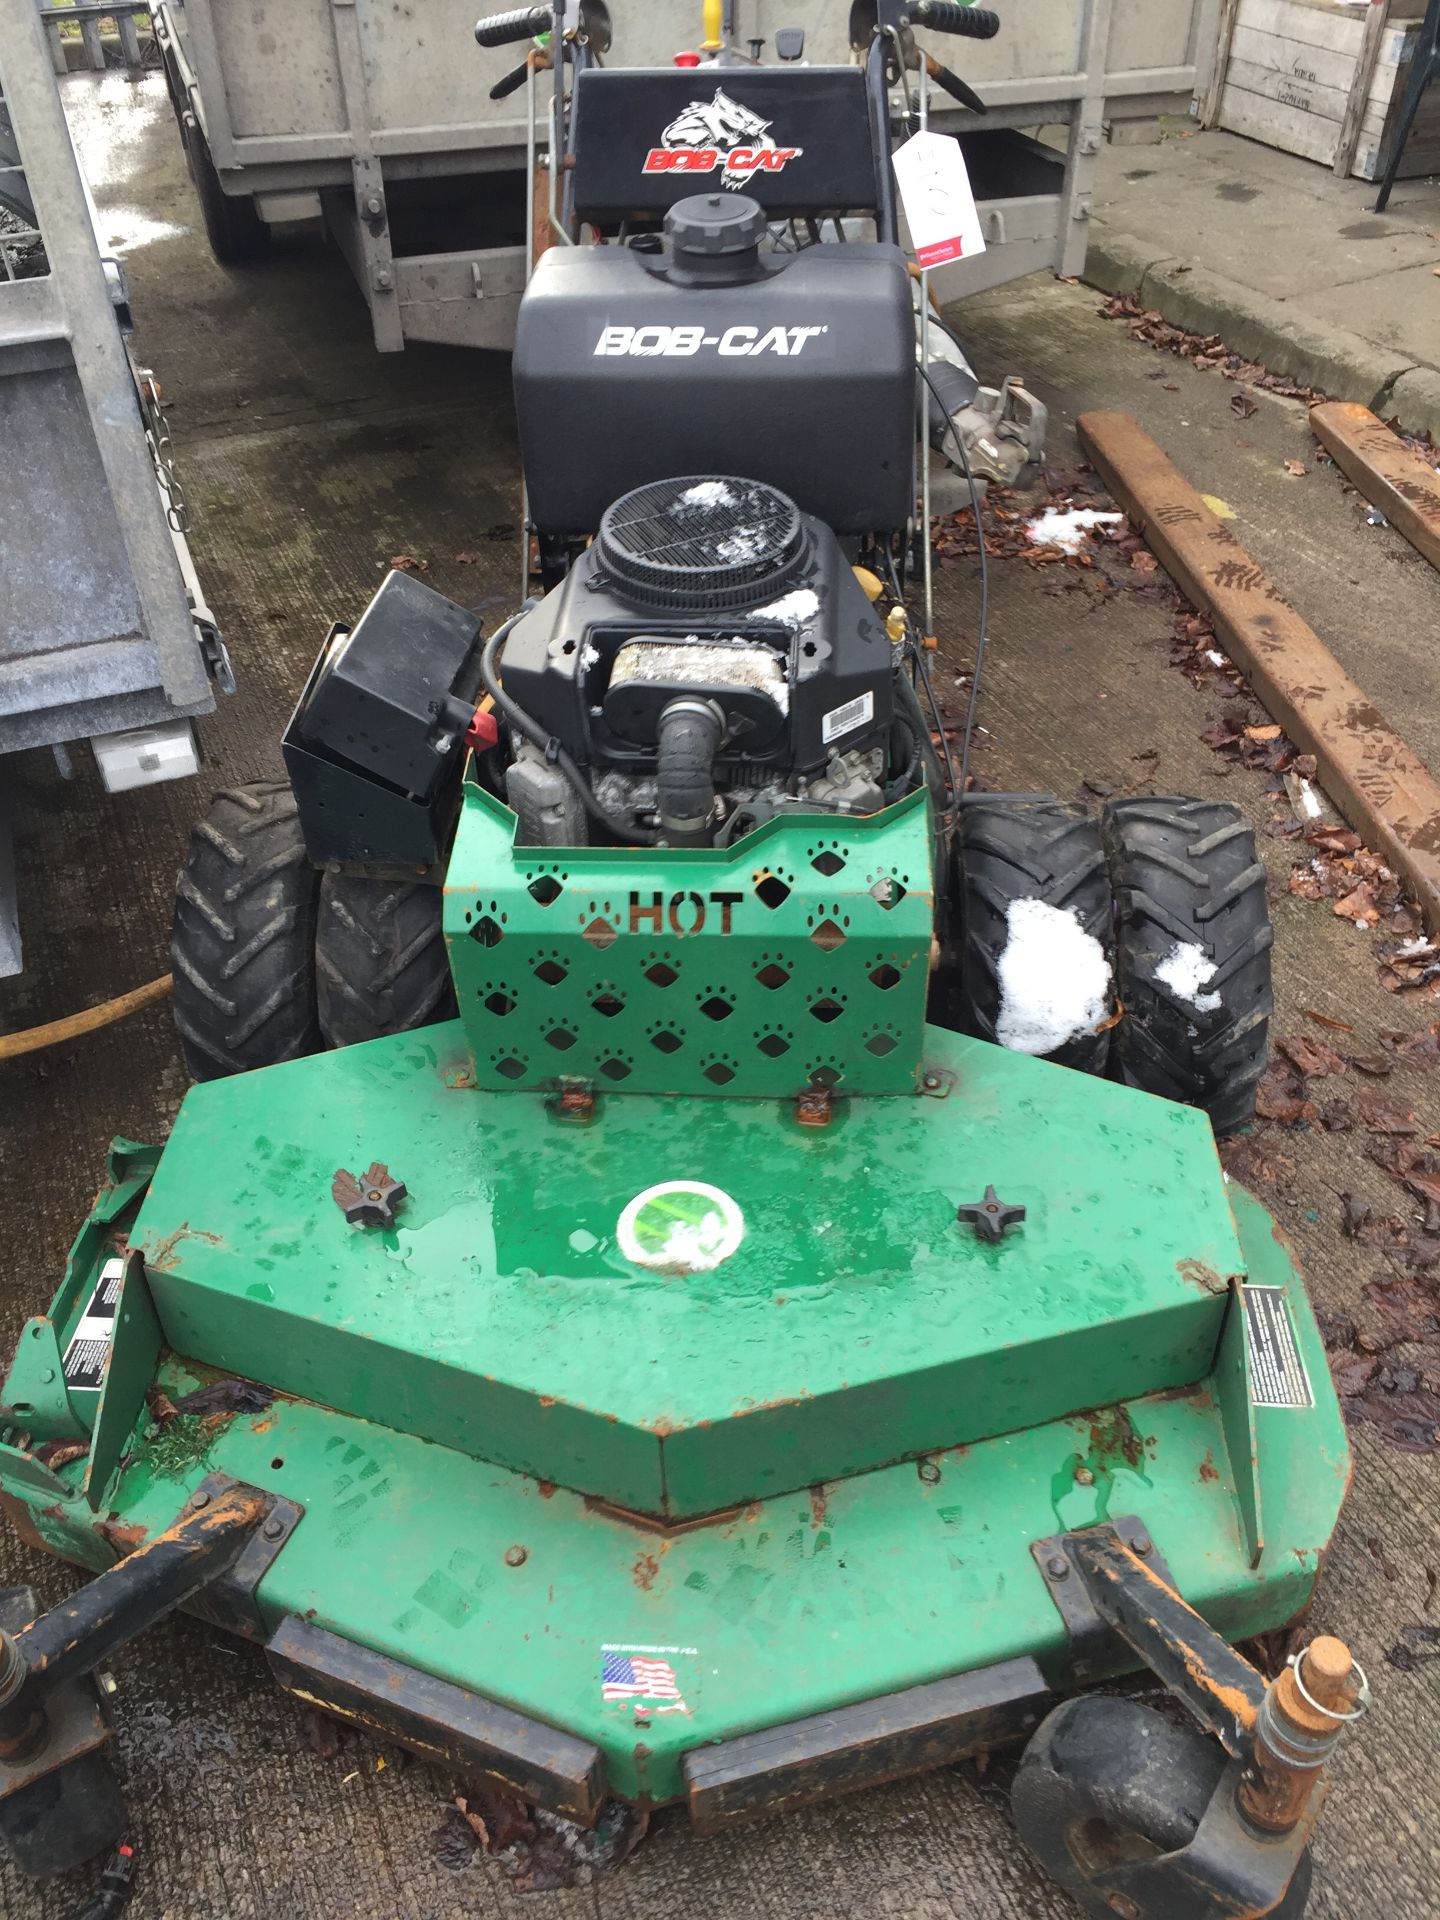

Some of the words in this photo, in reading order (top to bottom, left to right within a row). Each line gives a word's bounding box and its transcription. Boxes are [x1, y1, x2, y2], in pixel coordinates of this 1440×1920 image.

[643, 149, 800, 172] BOB-CAT
[593, 326, 823, 356] BOB-CAT
[629, 891, 743, 936] HOT
